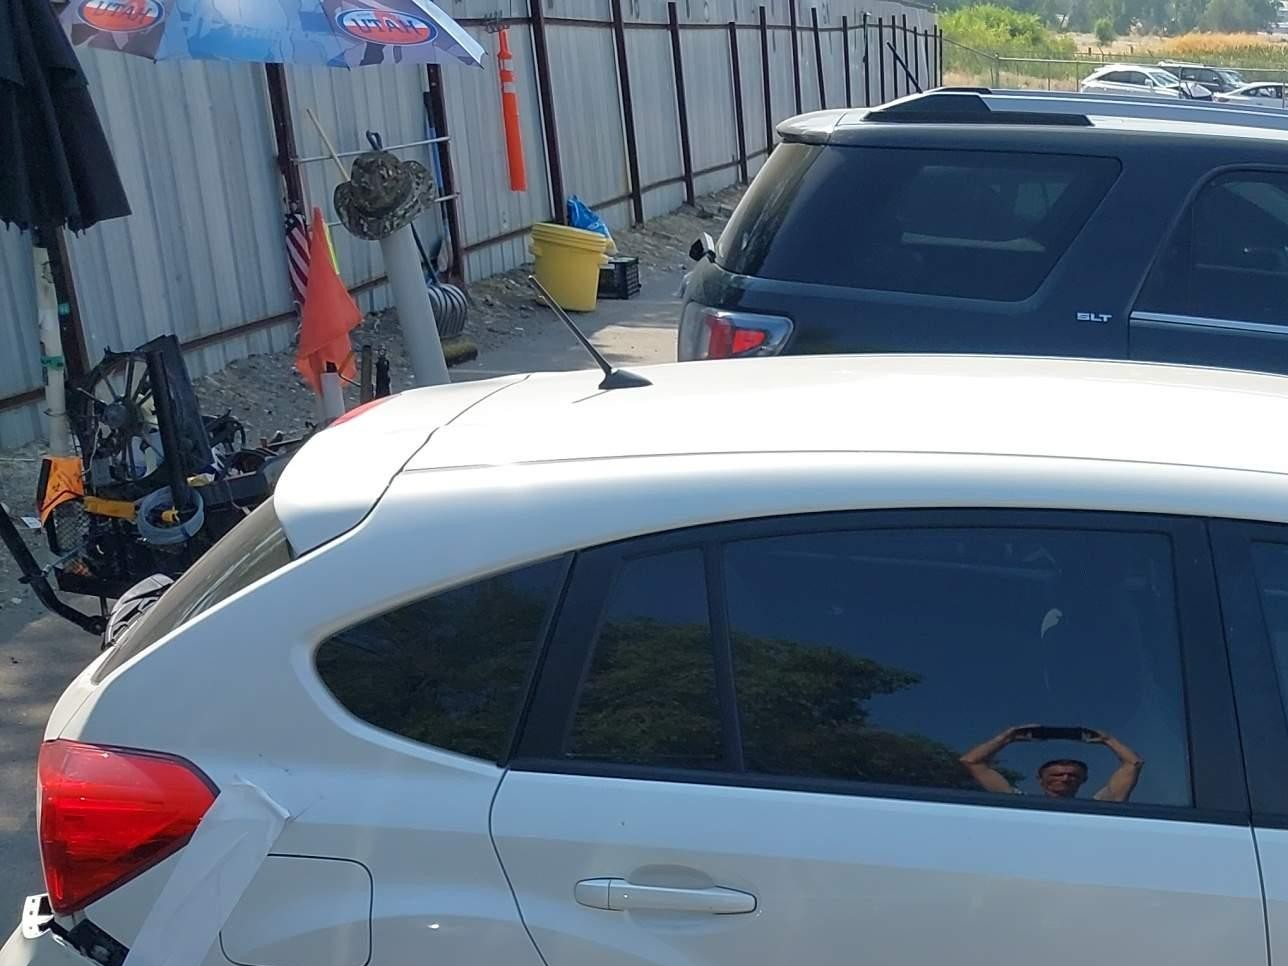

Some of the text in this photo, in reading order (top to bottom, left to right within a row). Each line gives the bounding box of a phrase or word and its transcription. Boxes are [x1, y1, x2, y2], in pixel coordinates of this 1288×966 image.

[94, 1, 153, 25] UTAH
[351, 18, 422, 36] UTAH
[1077, 312, 1113, 322] SLT
